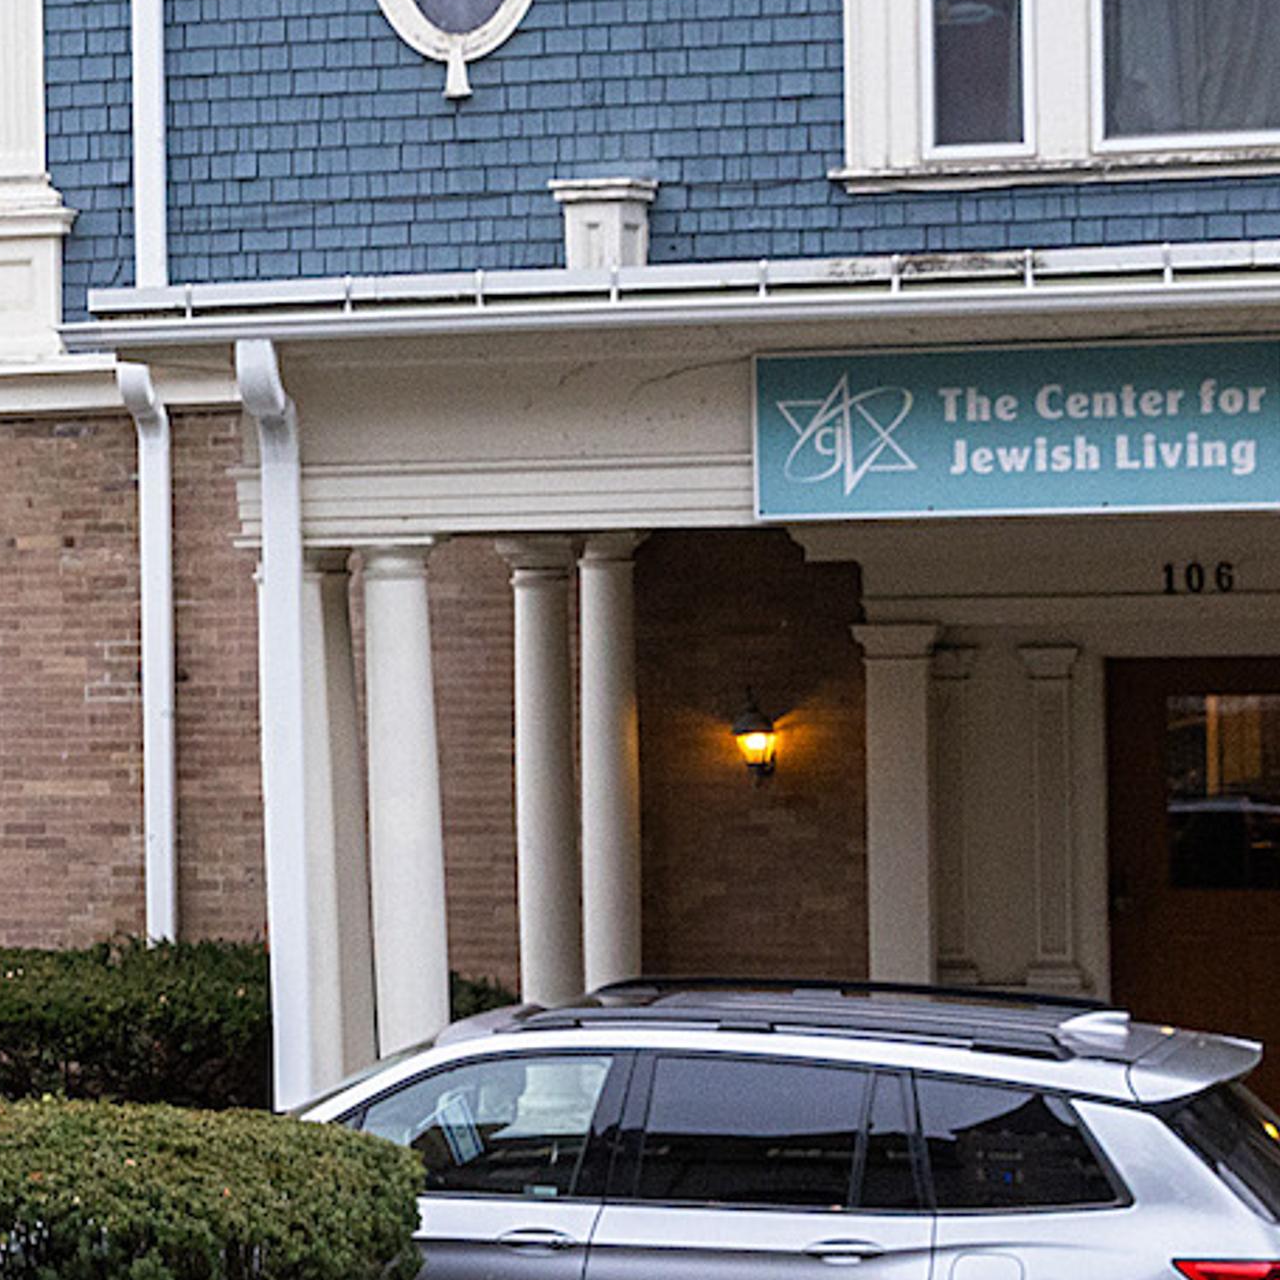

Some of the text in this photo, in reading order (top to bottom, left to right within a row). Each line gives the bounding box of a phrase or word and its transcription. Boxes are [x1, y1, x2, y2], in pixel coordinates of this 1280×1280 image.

[939, 378, 1267, 421] The Center for
[950, 432, 1257, 475] Jewish Living
[1163, 561, 1235, 594] 106
